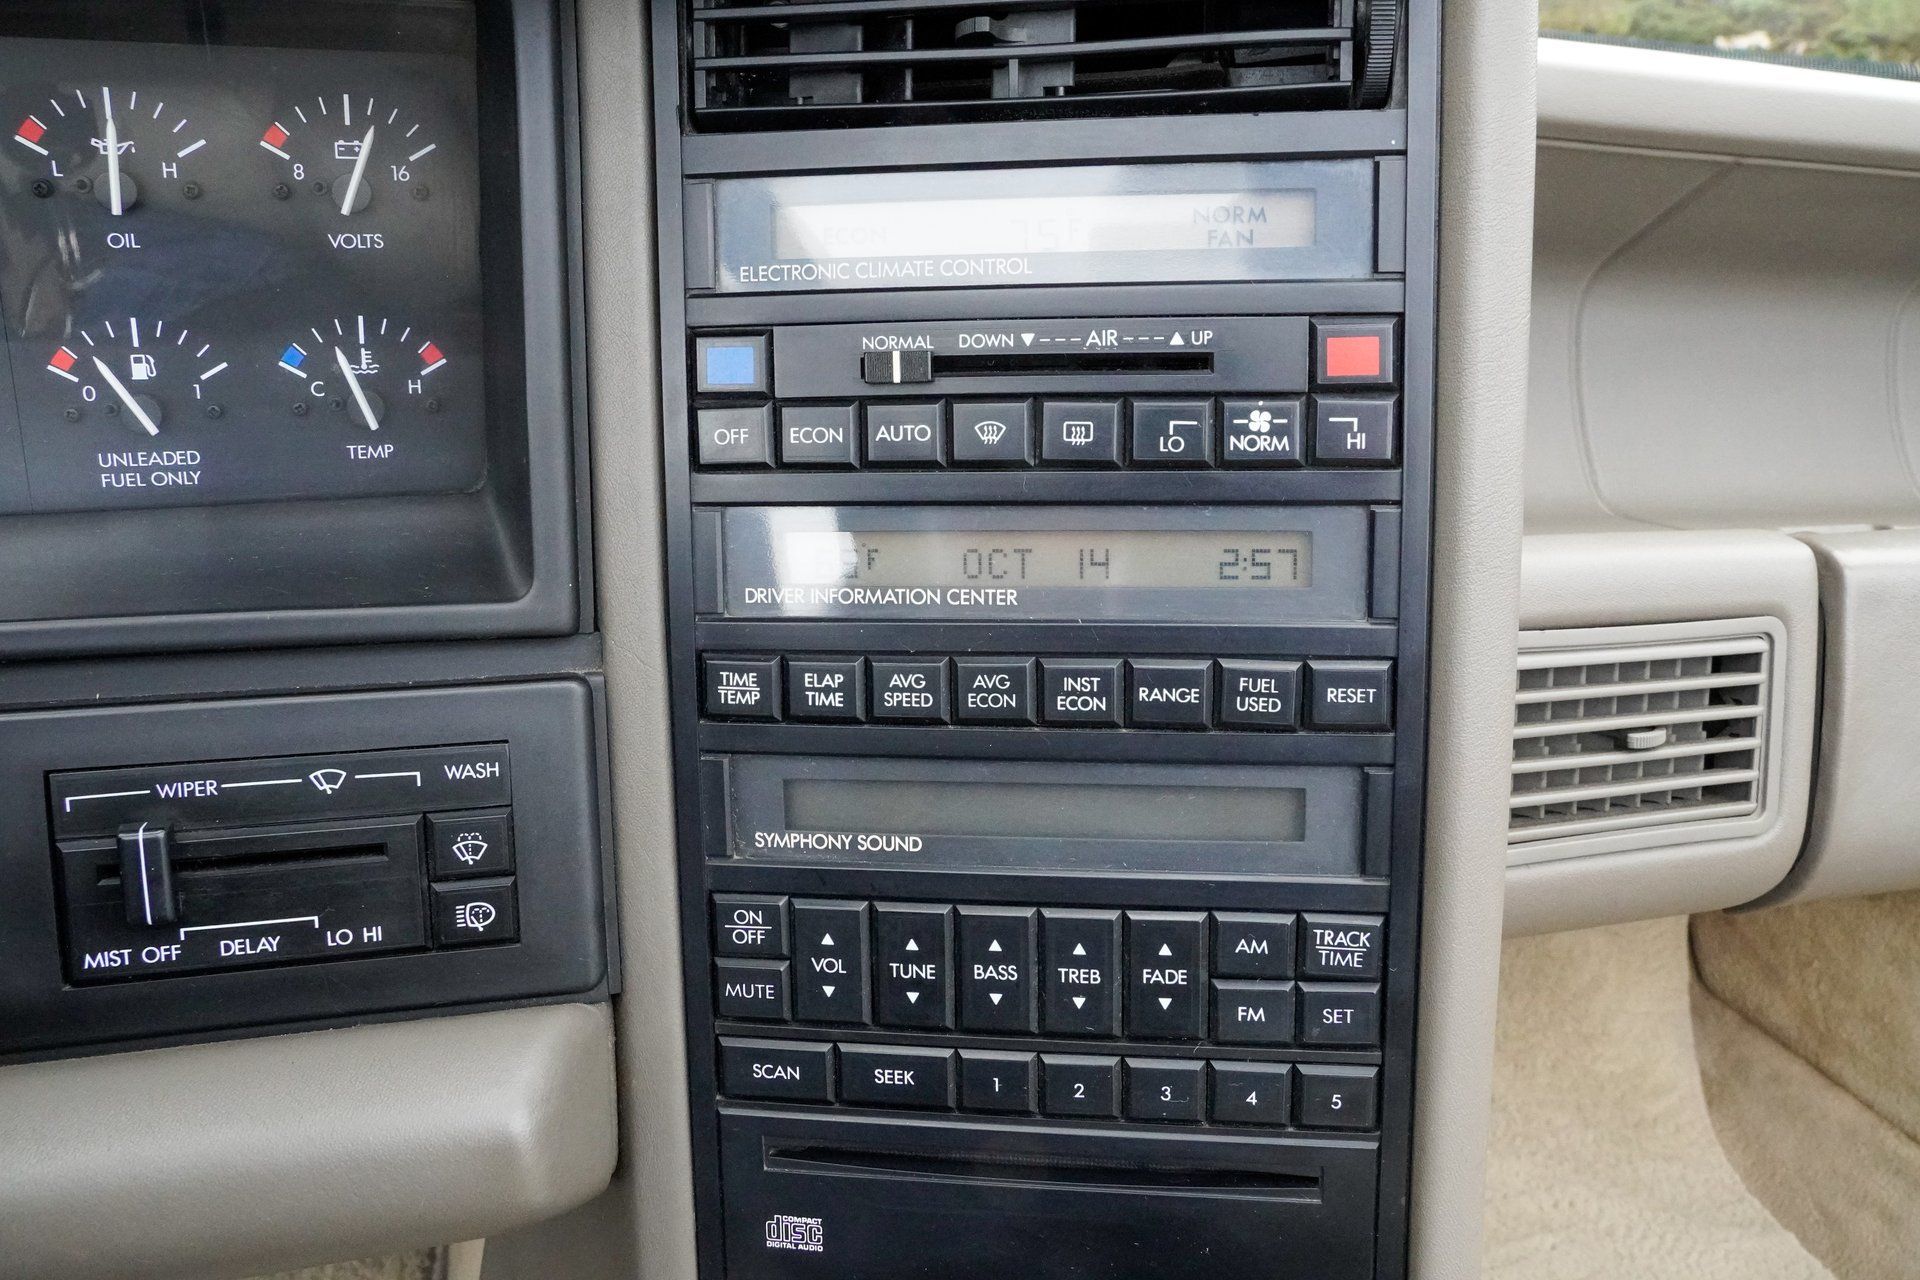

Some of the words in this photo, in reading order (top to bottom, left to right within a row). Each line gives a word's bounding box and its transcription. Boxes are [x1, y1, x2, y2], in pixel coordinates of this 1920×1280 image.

[52, 161, 63, 176] L
[163, 162, 177, 178] H
[294, 164, 304, 180] 8
[391, 166, 409, 181] 16
[1192, 205, 1268, 226] NORM
[107, 233, 140, 248] OIL
[328, 234, 383, 248] VOLTS
[1208, 229, 1254, 246] FAN
[740, 263, 851, 282] ELECTRONIC
[856, 260, 933, 278] CLIMATE
[940, 258, 1032, 276] CONTROL
[863, 336, 934, 350] NORMAL
[959, 334, 1013, 348] DOWN
[1087, 330, 1117, 344] AIR
[1192, 331, 1213, 345] UP
[83, 386, 95, 401] 0
[193, 384, 200, 399] 1
[311, 381, 324, 396] C
[409, 380, 421, 394] H
[714, 429, 748, 445] OFF
[790, 427, 842, 443] ECON
[876, 425, 931, 441] AUTO
[1160, 436, 1184, 452] LO
[1230, 435, 1289, 451] NORM
[1347, 433, 1365, 449] HI
[99, 451, 200, 467] UNLEADED
[346, 445, 393, 459] TEMP
[101, 473, 146, 487] FUEL
[151, 471, 200, 486] ONLY
[964, 549, 1032, 579] OCT
[1080, 549, 1109, 579] 14
[1220, 549, 1297, 580] 2:57
[744, 587, 804, 605] DRIVER
[809, 587, 942, 605] INFORMATION
[947, 589, 1017, 605] CENTER
[720, 672, 757, 686] TIME
[805, 673, 843, 688] ELAP
[890, 674, 925, 688] AVG
[973, 675, 1010, 689] AVG
[1064, 677, 1100, 691] INST
[1240, 678, 1278, 693] FUEL
[718, 690, 760, 704] TEMP
[805, 692, 843, 706] TIME
[884, 692, 933, 707] SPEED
[968, 693, 1015, 707] ECON
[1139, 687, 1199, 703] RANGE
[1328, 688, 1376, 703] RESET
[1058, 696, 1105, 711] ECON
[1237, 697, 1281, 712] USED
[444, 762, 499, 779] WASH
[156, 780, 217, 798] WIPER
[755, 832, 852, 849] SYMPHONY
[858, 835, 922, 851] SOUND
[734, 910, 762, 924] ON
[327, 929, 353, 946] LO
[363, 926, 382, 942] HI
[733, 929, 765, 944] OFF
[1313, 930, 1370, 947] TRACK
[220, 936, 280, 956] DELAY
[1235, 939, 1268, 954] AM
[85, 949, 132, 969] MIST
[142, 945, 181, 963] OFF
[1319, 950, 1363, 967] TIME
[811, 958, 846, 973] VOL
[889, 963, 935, 979] TUNE
[974, 965, 1017, 980] BASS
[1058, 968, 1100, 984] TREB
[1143, 969, 1187, 984] FADE
[726, 984, 774, 999] MUTE
[1238, 1007, 1265, 1021] FM
[1323, 1009, 1354, 1023] SET
[753, 1064, 799, 1080] SCAN
[875, 1069, 914, 1085] SEEK
[993, 1078, 998, 1091] 1
[1074, 1084, 1084, 1098] 2
[1161, 1086, 1171, 1101] 3
[1246, 1091, 1257, 1105] 4
[1331, 1095, 1341, 1109] 5
[783, 1216, 822, 1224] COMPACT
[767, 1241, 796, 1249] DIGITAL
